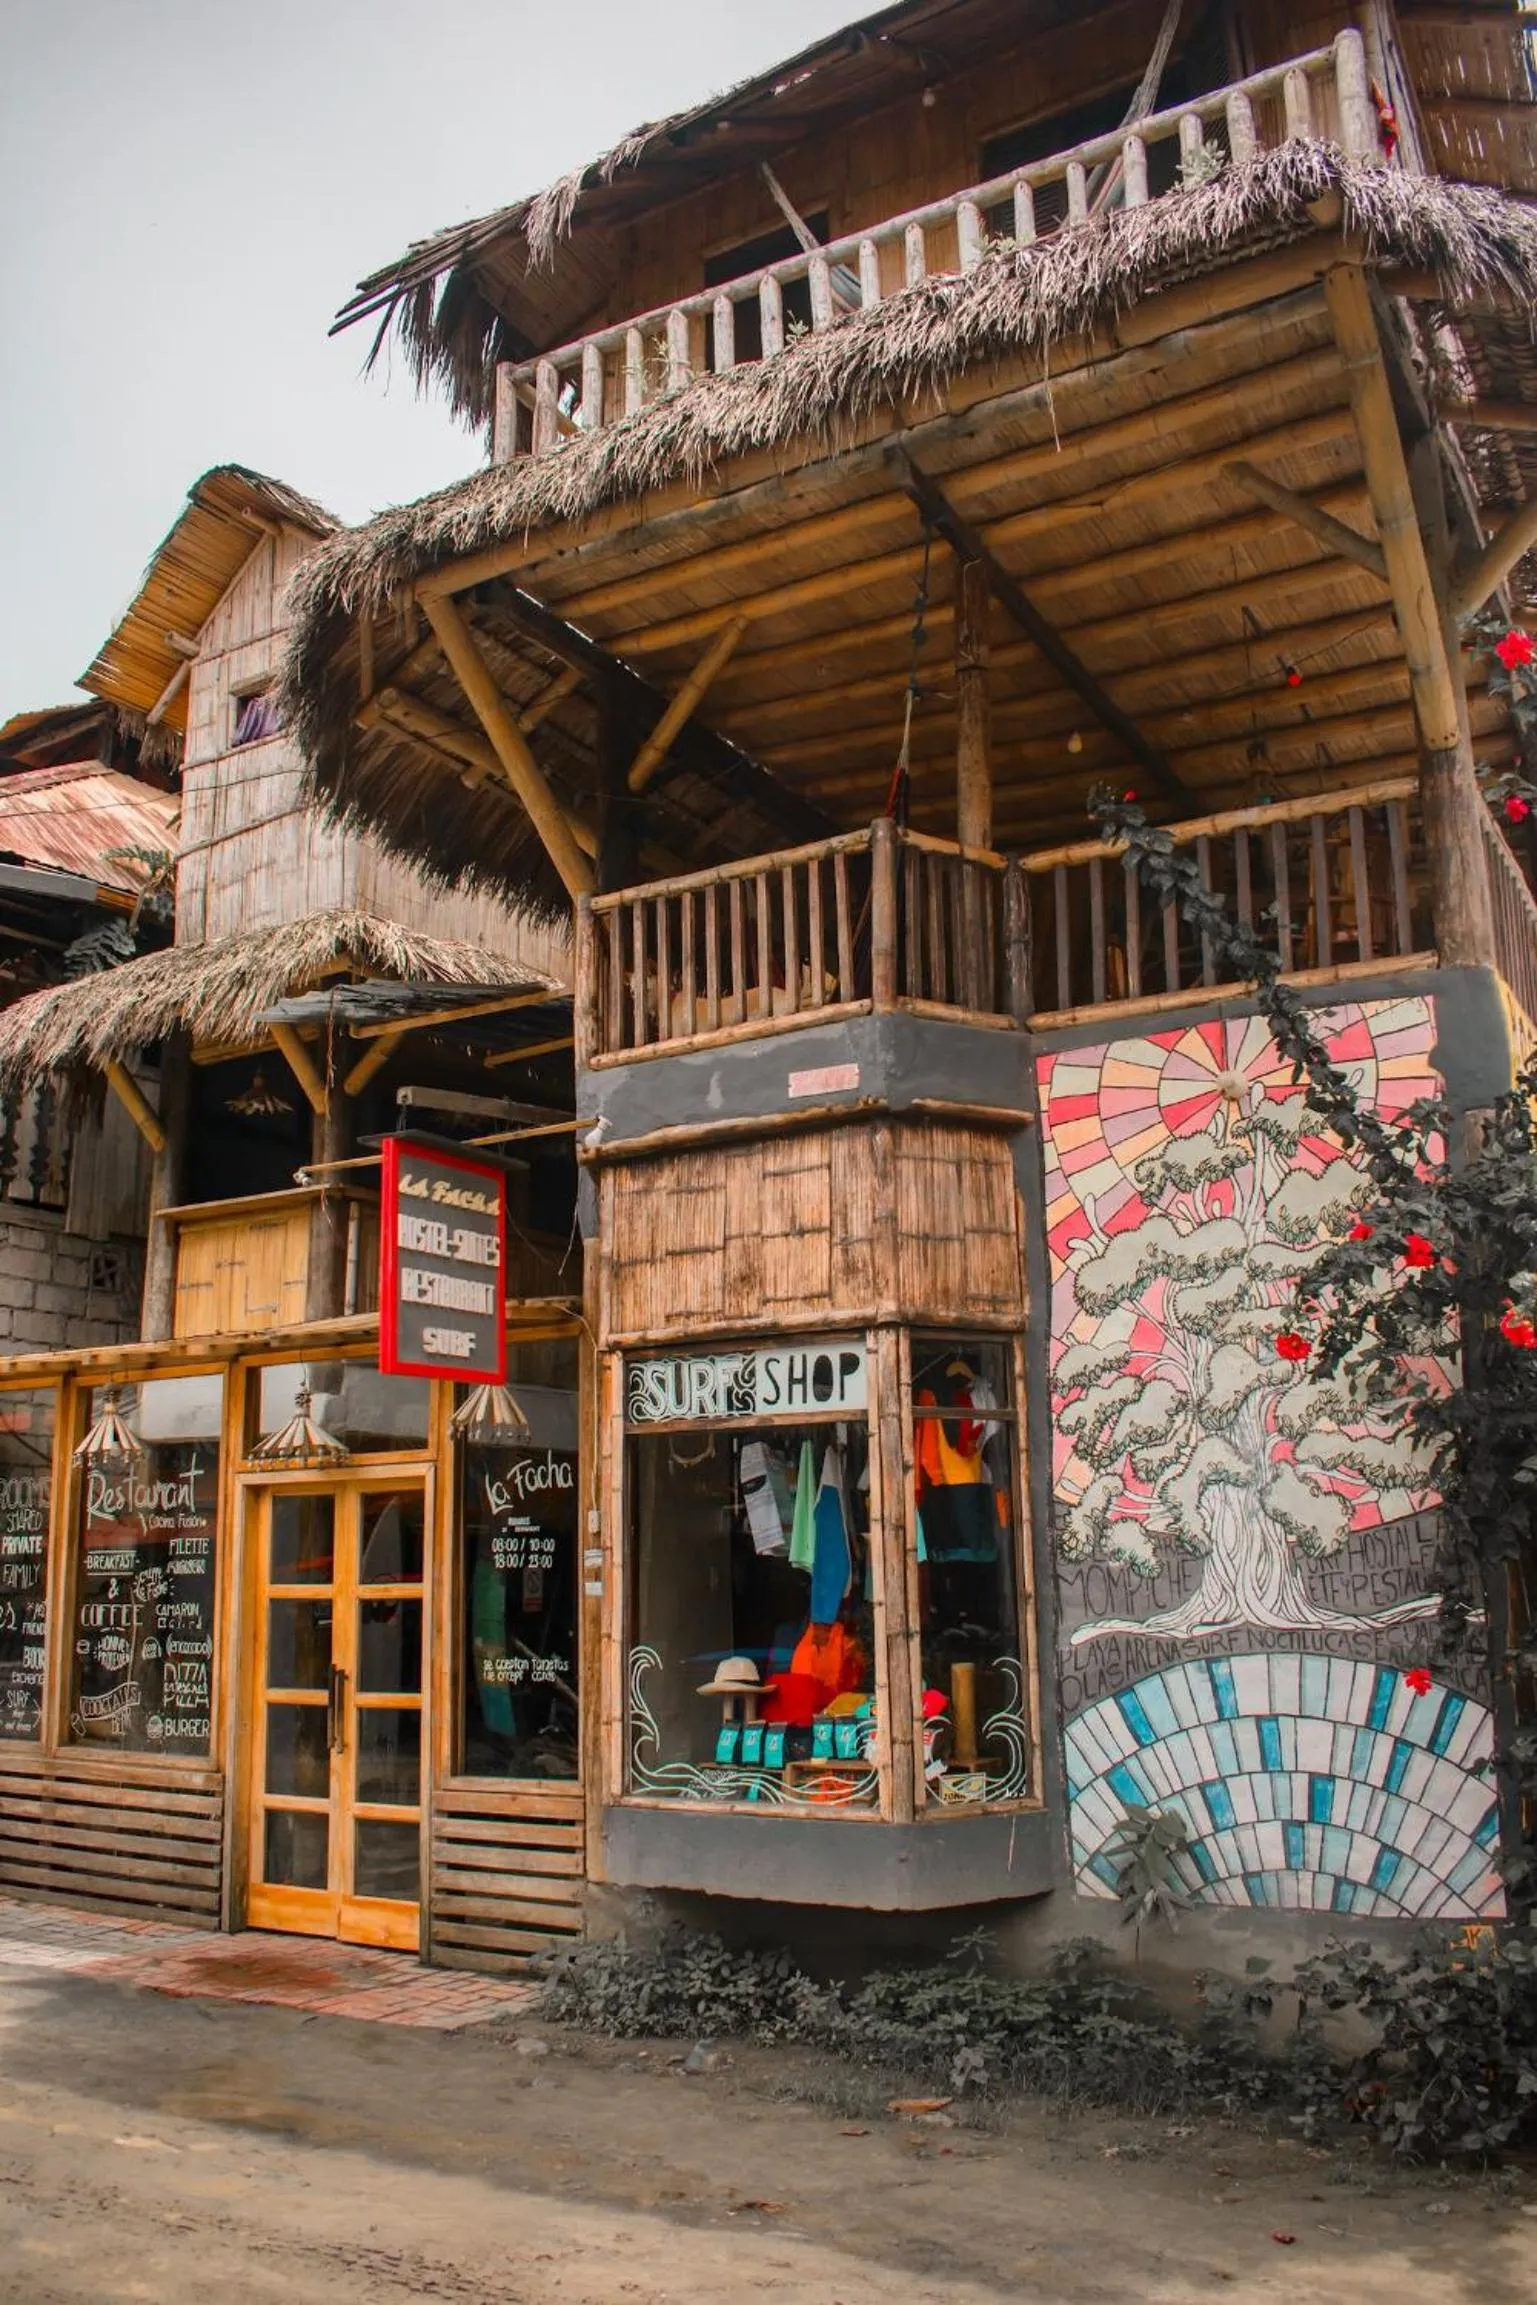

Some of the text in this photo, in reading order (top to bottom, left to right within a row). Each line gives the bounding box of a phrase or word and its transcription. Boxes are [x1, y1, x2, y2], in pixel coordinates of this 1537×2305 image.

[422, 1325, 476, 1358] SURF
[642, 1351, 860, 1419] SURF SHOP
[506, 1449, 574, 1500] Facha
[2, 1535, 43, 1554] PRIVATE
[2, 1563, 41, 1590] FAMILY
[81, 1603, 144, 1627] COFFEE
[164, 1719, 210, 1738] BURGER
